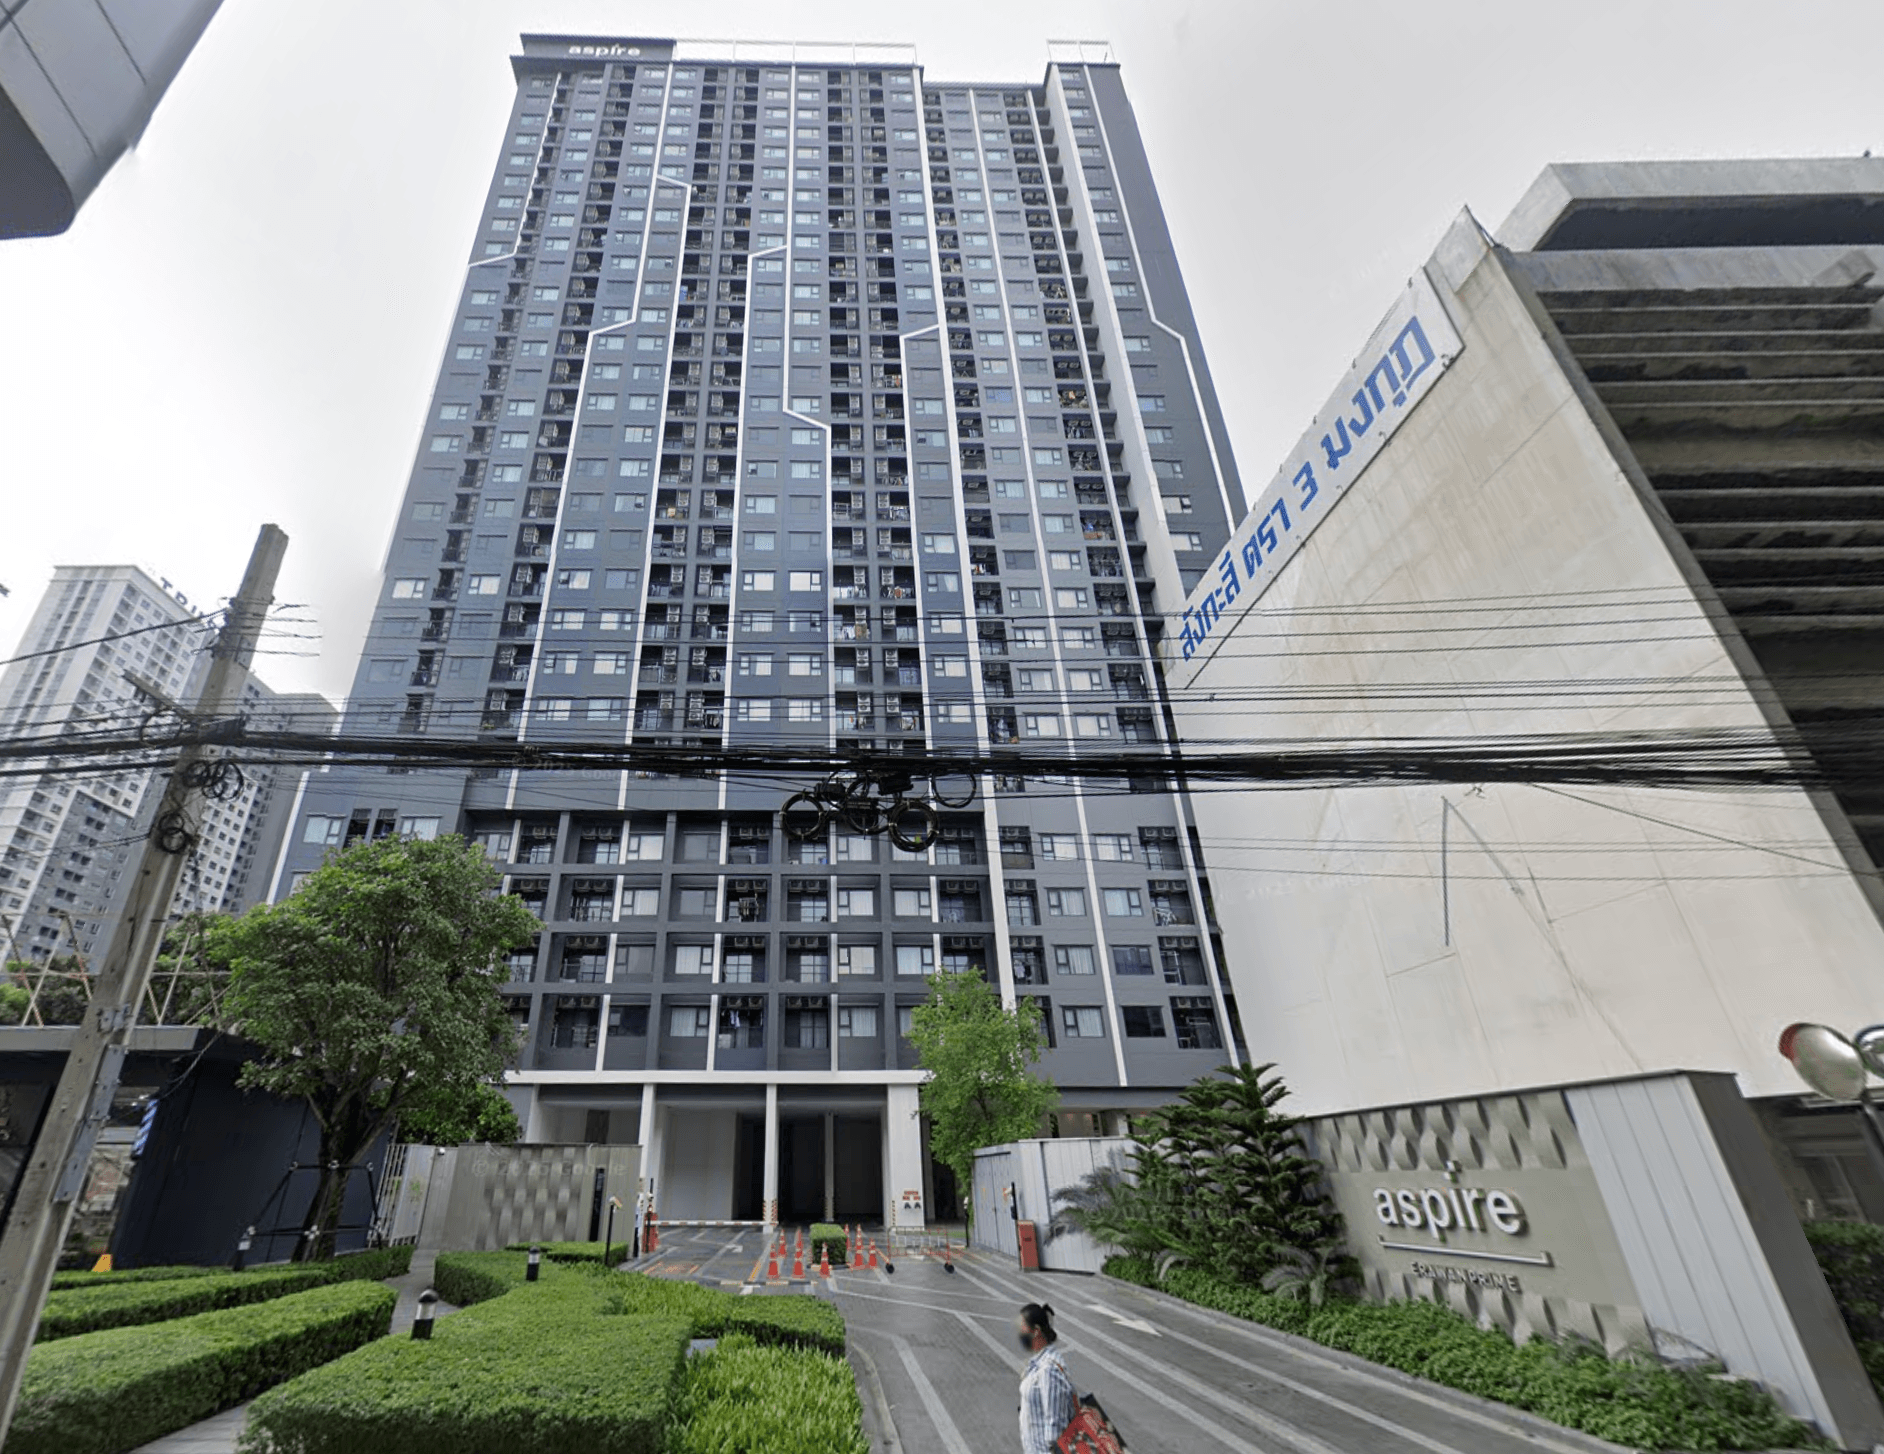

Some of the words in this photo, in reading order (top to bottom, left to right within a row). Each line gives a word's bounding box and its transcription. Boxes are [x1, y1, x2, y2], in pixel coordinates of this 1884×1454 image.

[1180, 551, 1241, 662] สังกะสี
[1292, 461, 1319, 511] 3
[1321, 315, 1436, 471] มงกุฎ
[1373, 1168, 1521, 1239] aspire
